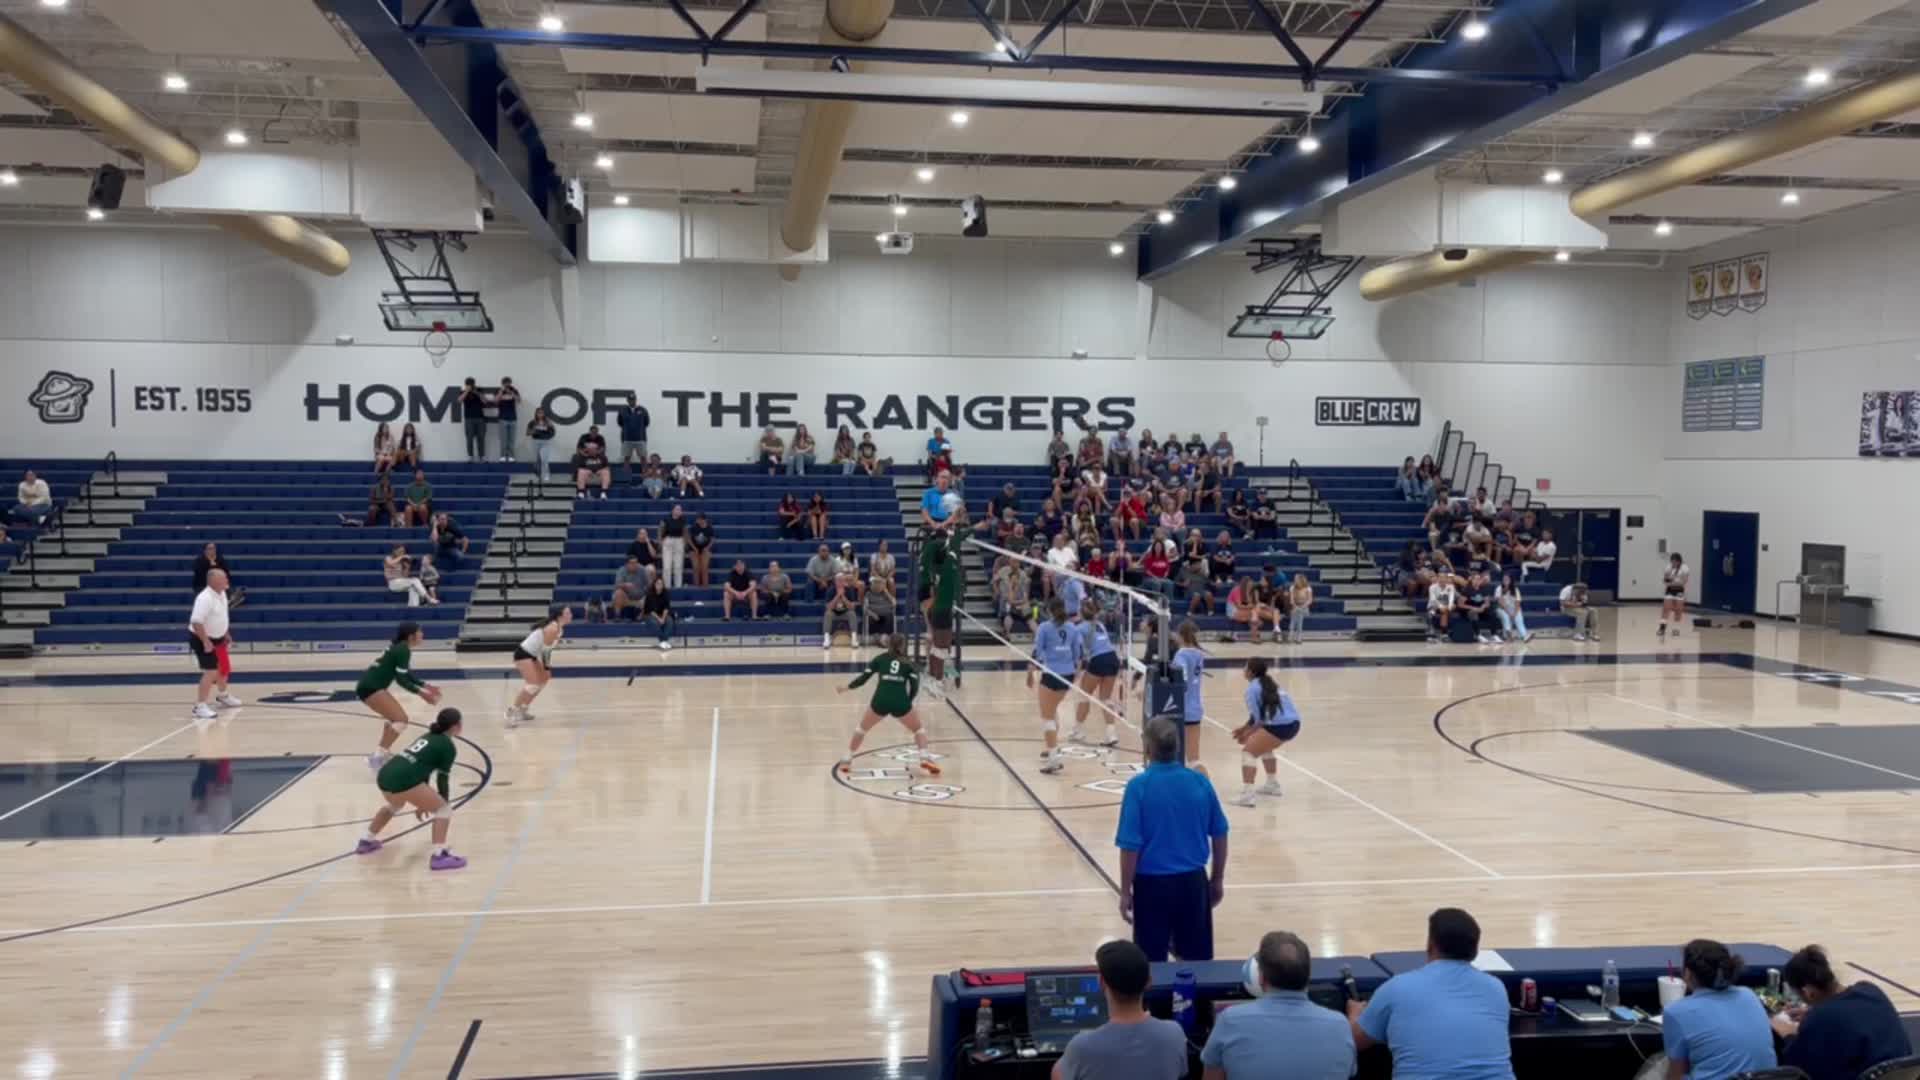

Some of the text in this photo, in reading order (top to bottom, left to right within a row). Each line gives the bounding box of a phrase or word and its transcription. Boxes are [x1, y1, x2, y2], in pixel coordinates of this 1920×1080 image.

[134, 386, 252, 413] EST. 1955
[540, 387, 635, 426] OF
[661, 389, 798, 429] THE
[825, 393, 1136, 432] RANGERS
[1320, 401, 1417, 422] BLUE CREW
[890, 660, 900, 674] 9
[410, 739, 428, 752] 8
